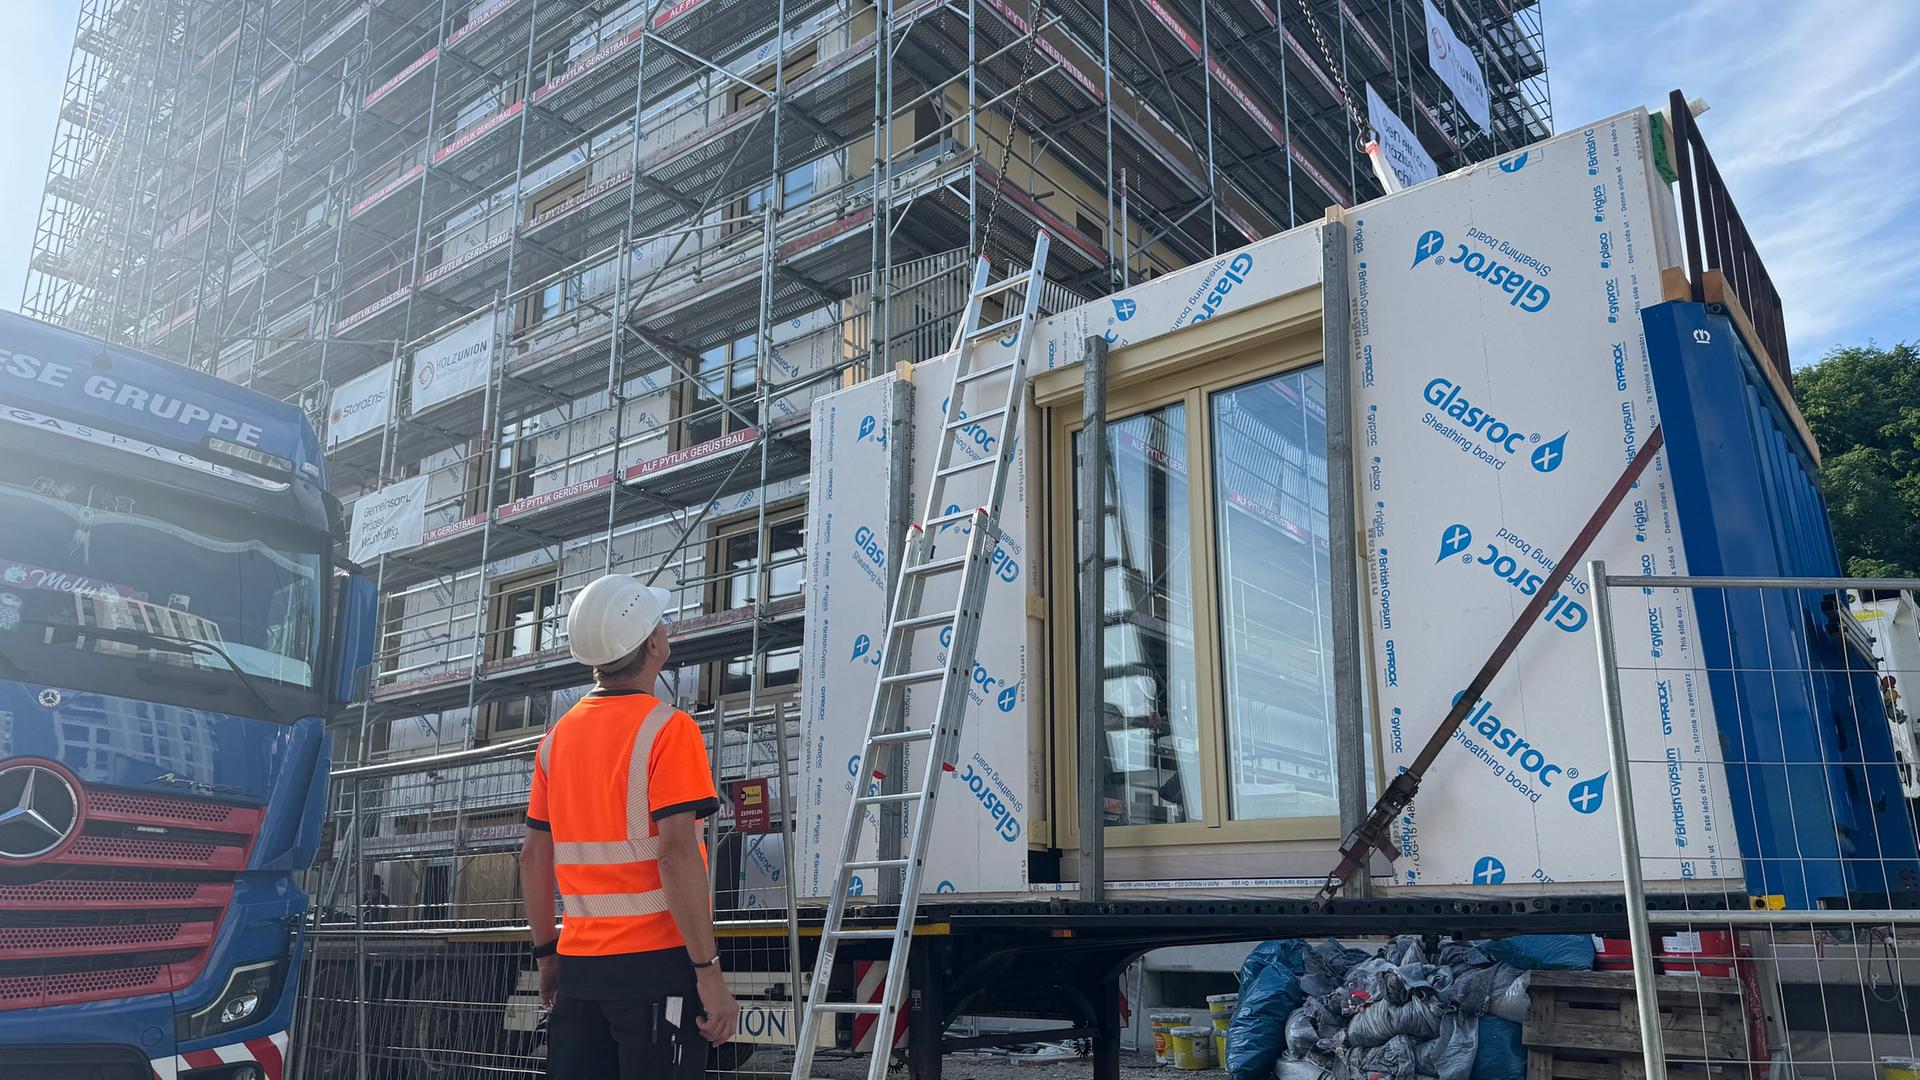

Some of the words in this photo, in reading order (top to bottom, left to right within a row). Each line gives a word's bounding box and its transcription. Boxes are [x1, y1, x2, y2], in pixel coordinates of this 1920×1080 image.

[1593, 184, 1603, 213] rigips
[1356, 228, 1365, 253] rigips
[1466, 227, 1499, 250] board
[1599, 232, 1609, 259] placo
[1498, 241, 1552, 278] Sheathing
[1189, 258, 1226, 306] Sheathing
[1449, 243, 1551, 313] Glasroc
[1606, 279, 1617, 314] gyproc
[435, 339, 488, 371] HOLZUNION
[1364, 345, 1375, 388] GYPROCK
[1612, 343, 1626, 391] GYPROCK
[83, 375, 264, 448] GRUPPE
[1423, 377, 1526, 454] Glasroc
[1369, 412, 1379, 446] gyproc
[1421, 412, 1473, 452] Sheathing
[1472, 444, 1506, 471] board
[641, 460, 657, 474] ALF
[659, 451, 689, 469] PYTLIK
[1371, 464, 1381, 491] placo
[511, 500, 526, 514] ALF
[526, 493, 552, 510] PYTLIK
[1634, 500, 1645, 531] rigips
[423, 529, 437, 541] TLIK
[1374, 510, 1385, 537] rigips
[1496, 527, 1531, 556] board
[1477, 543, 1589, 633] Glsroc
[1651, 607, 1664, 646] gyproc
[1385, 639, 1398, 688] GYPROCK
[1656, 680, 1672, 734] GYPROCK
[1391, 716, 1402, 753] gyproc
[1690, 719, 1698, 743] strona
[973, 752, 993, 776] board
[1451, 727, 1506, 777] Sheathing
[1504, 770, 1542, 804] board
[960, 764, 1021, 842] Glasroc
[992, 772, 1023, 813] Sheathing
[1700, 795, 1708, 812] lado
[1703, 814, 1711, 831] Este
[750, 838, 772, 873] Gasroc
[1401, 827, 1412, 858] rigips
